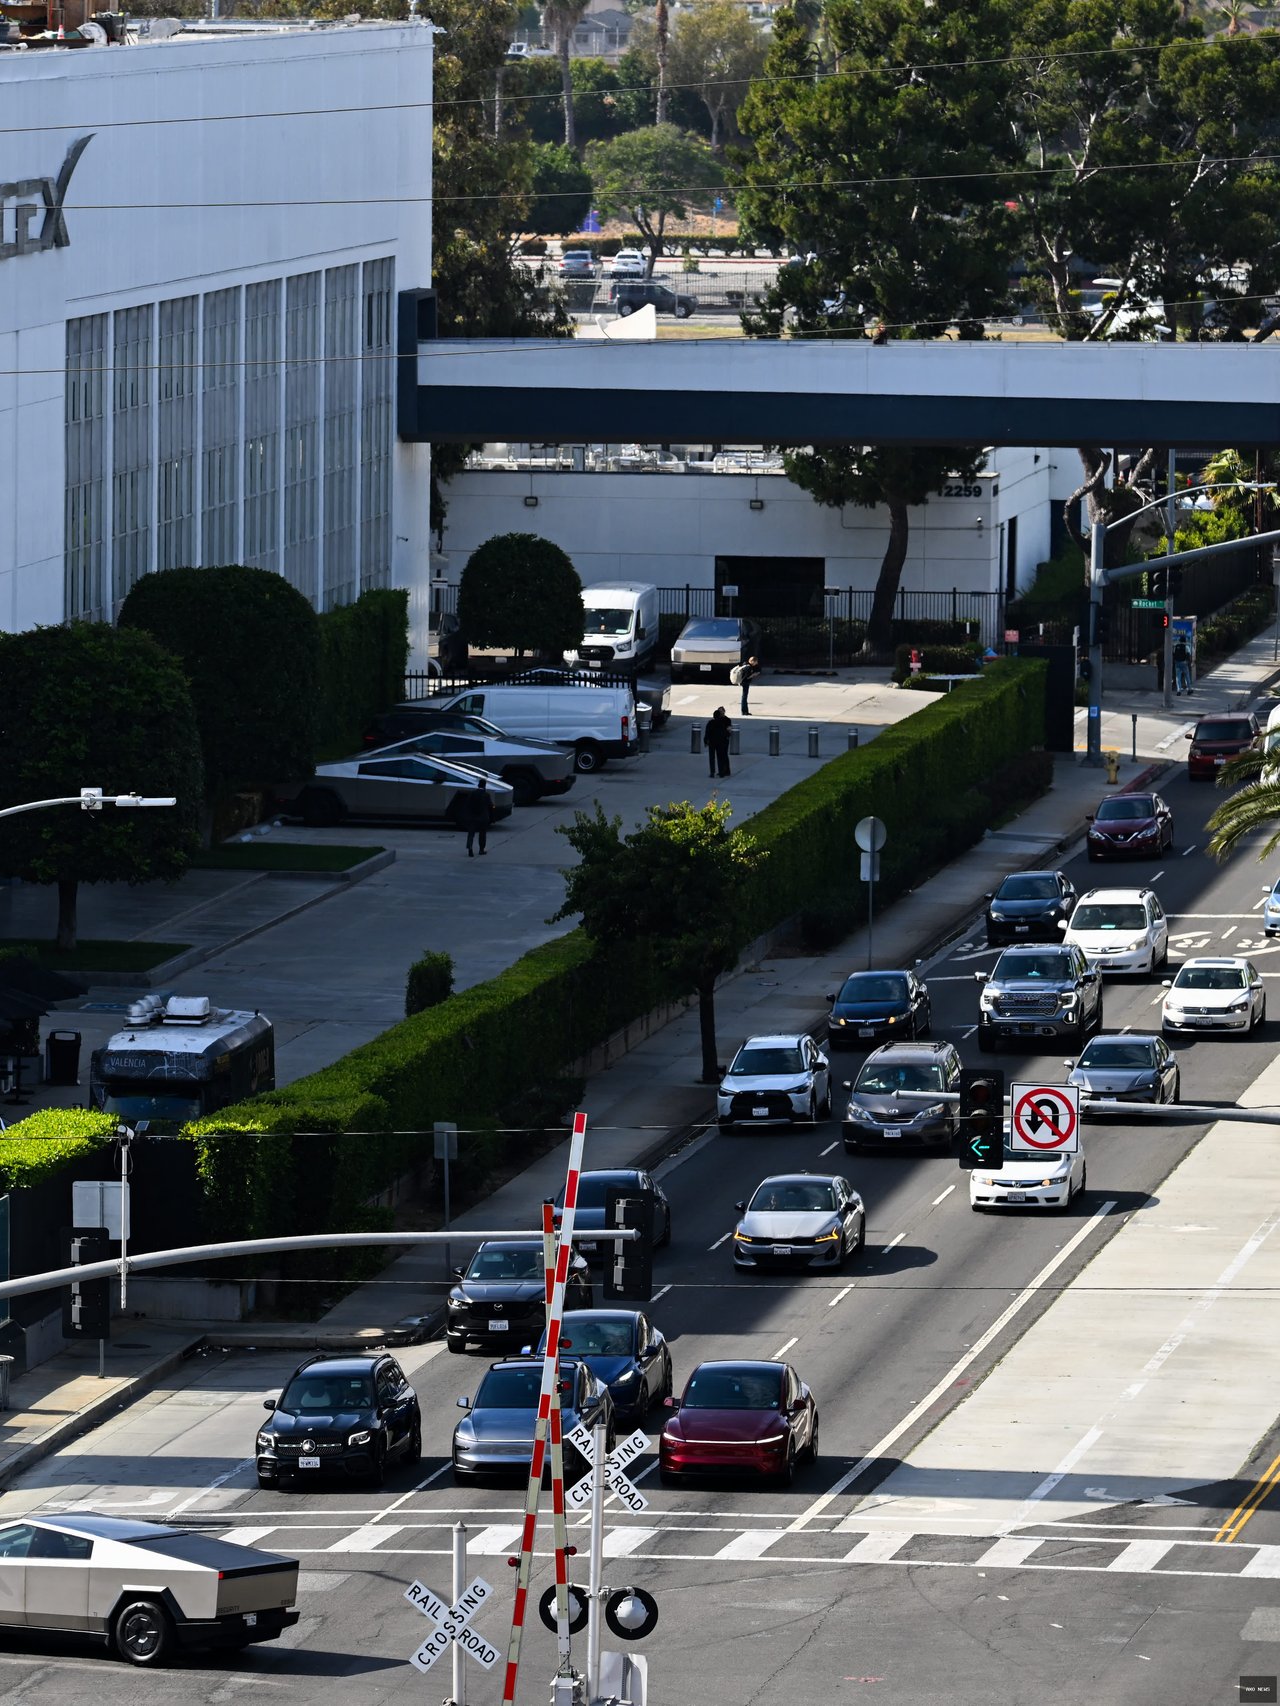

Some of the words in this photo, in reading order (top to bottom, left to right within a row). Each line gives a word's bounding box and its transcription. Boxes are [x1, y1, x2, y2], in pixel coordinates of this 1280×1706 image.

[110, 1057, 146, 1068] VALENCIA
[611, 1475, 644, 1511] ROAD
[408, 1584, 441, 1620] RAIL
[458, 1628, 495, 1663] ROAD
[417, 1585, 486, 1665] CROSSING
